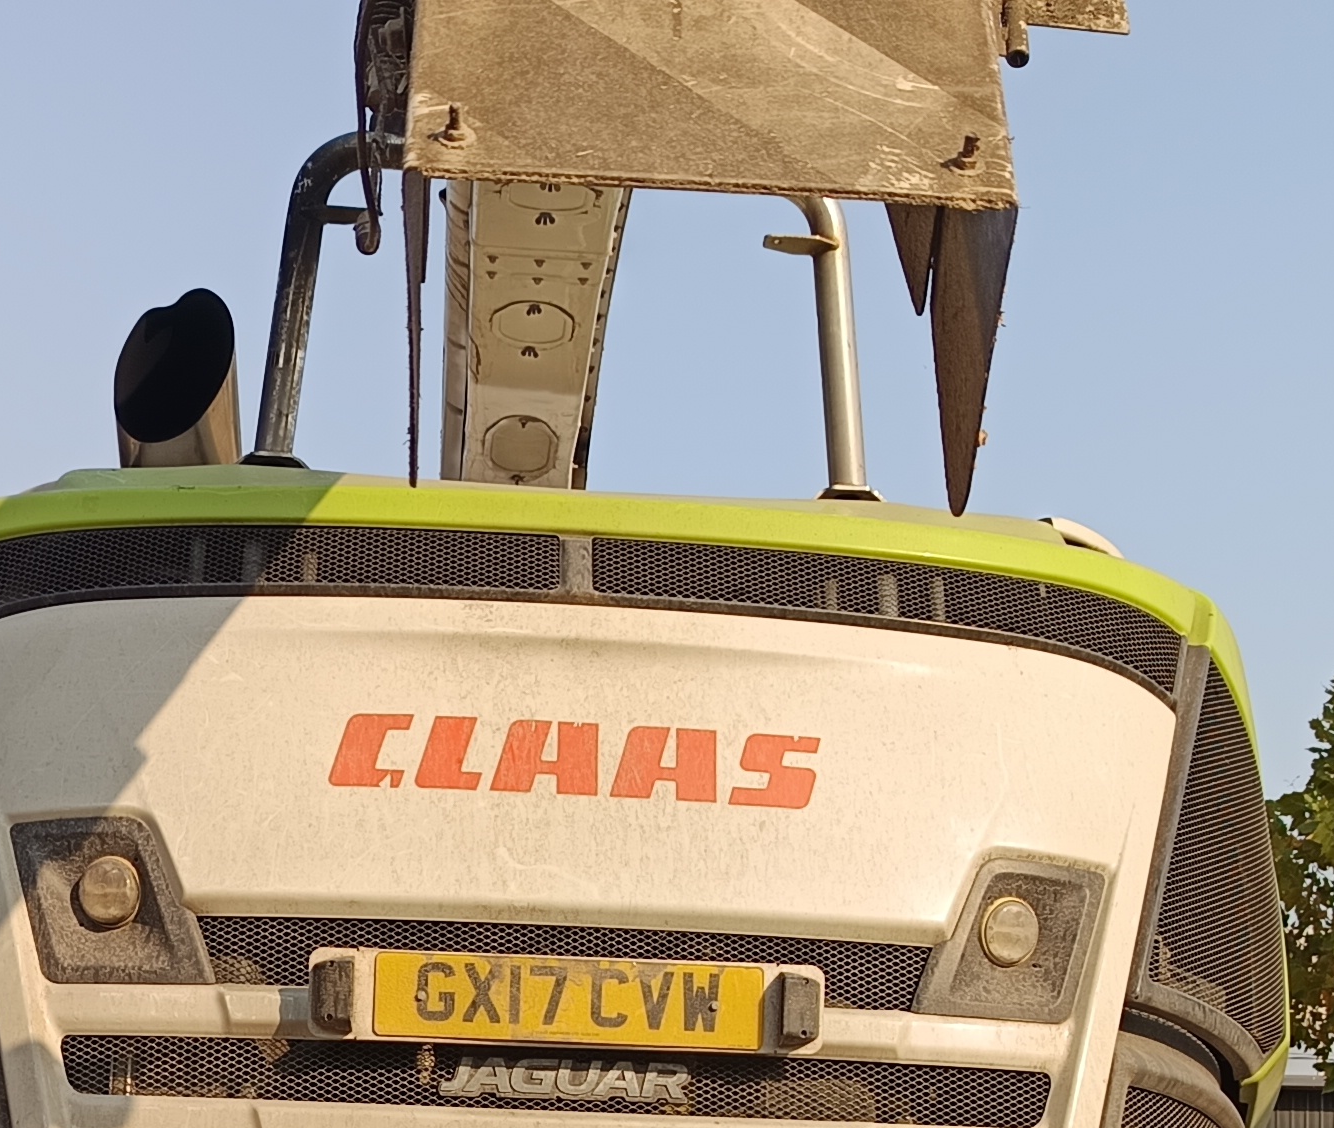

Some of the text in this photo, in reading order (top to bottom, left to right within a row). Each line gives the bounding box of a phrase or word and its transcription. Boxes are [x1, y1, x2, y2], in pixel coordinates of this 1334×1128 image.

[327, 713, 822, 809] CLAAS
[416, 961, 720, 1033] GX17 CVW
[438, 1056, 691, 1103] JAGUAR
